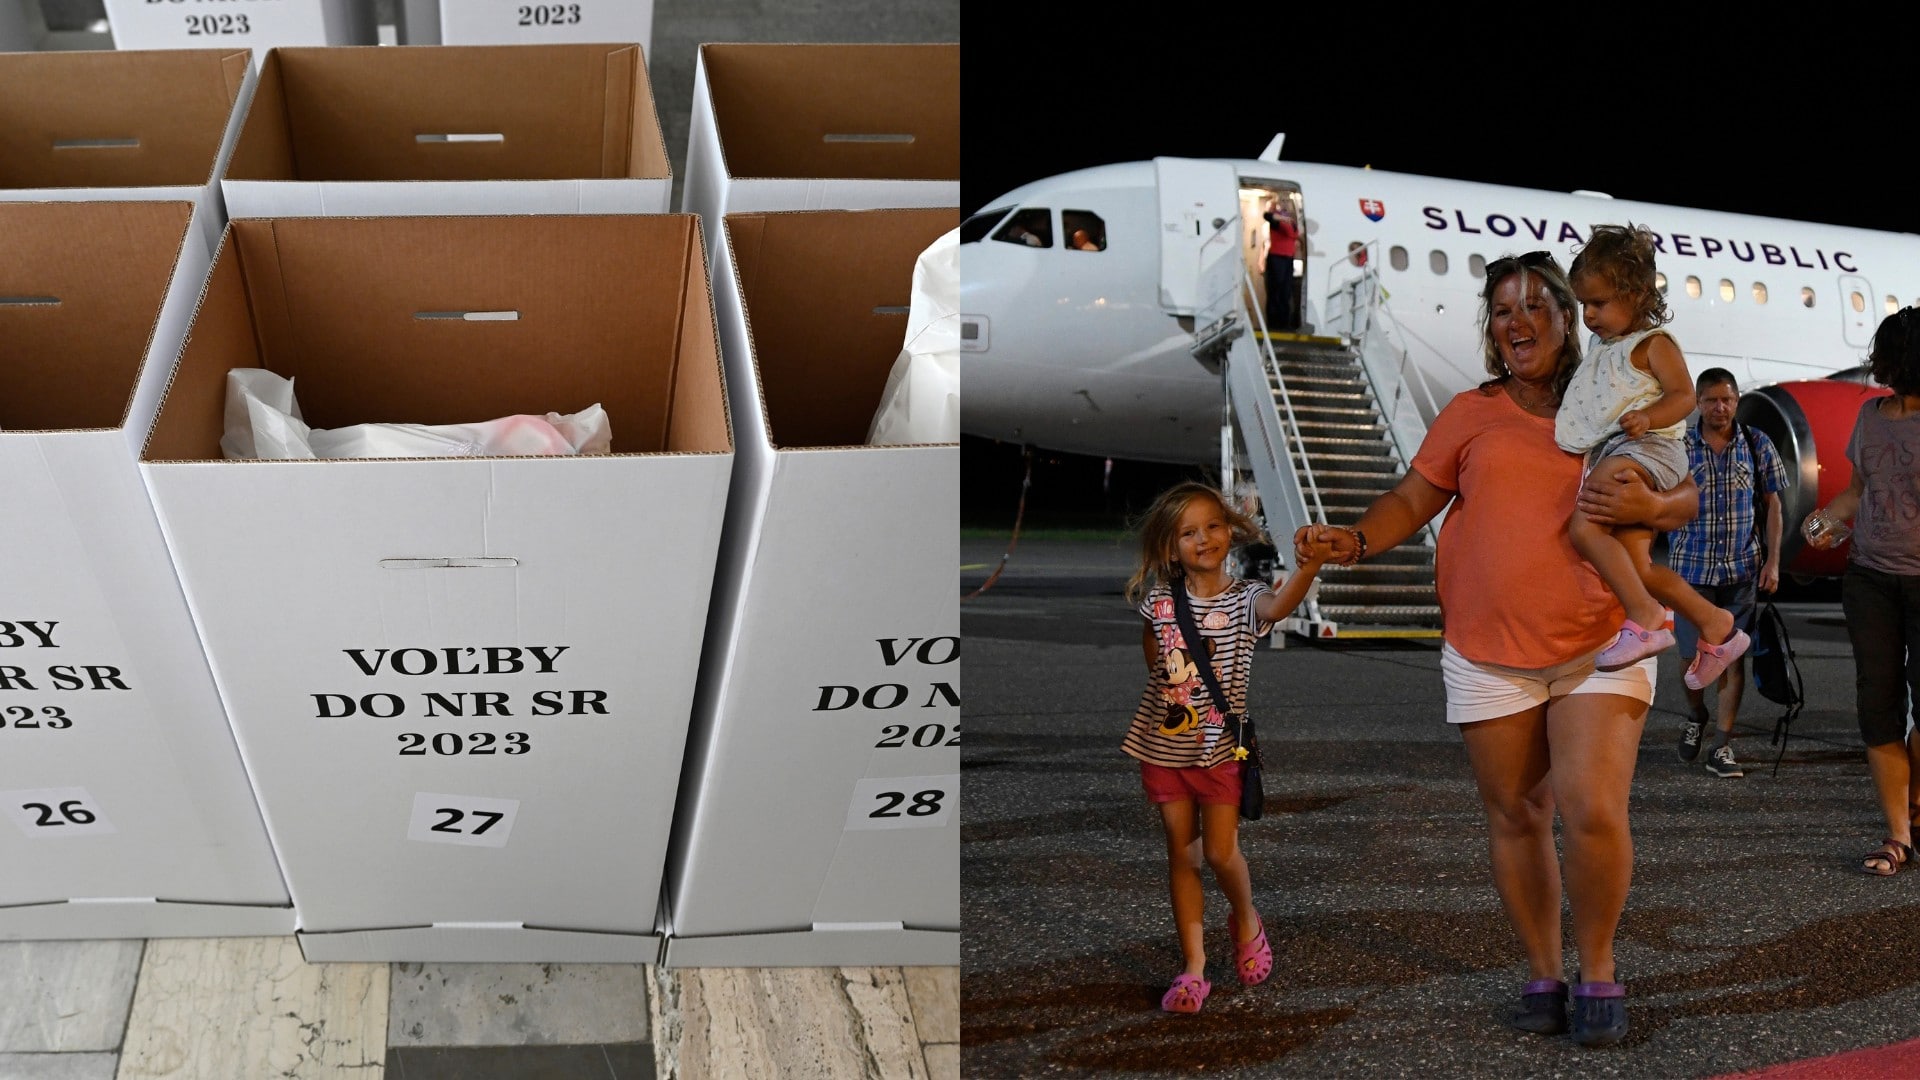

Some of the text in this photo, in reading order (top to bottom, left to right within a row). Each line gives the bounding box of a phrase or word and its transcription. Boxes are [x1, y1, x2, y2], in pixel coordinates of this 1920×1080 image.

[185, 14, 251, 36] 2023
[518, 3, 581, 26] 2023
[1422, 206, 1595, 245] SLOVA
[342, 646, 571, 676] VOĽBY
[875, 636, 959, 667] VO
[0, 665, 132, 690] R SR
[310, 690, 610, 718] DO NR SR
[811, 683, 909, 712] DO
[0, 706, 73, 729] 23
[397, 732, 531, 756] 2023
[22, 800, 96, 827] 26
[868, 789, 945, 819] 28
[430, 808, 504, 835] 27
